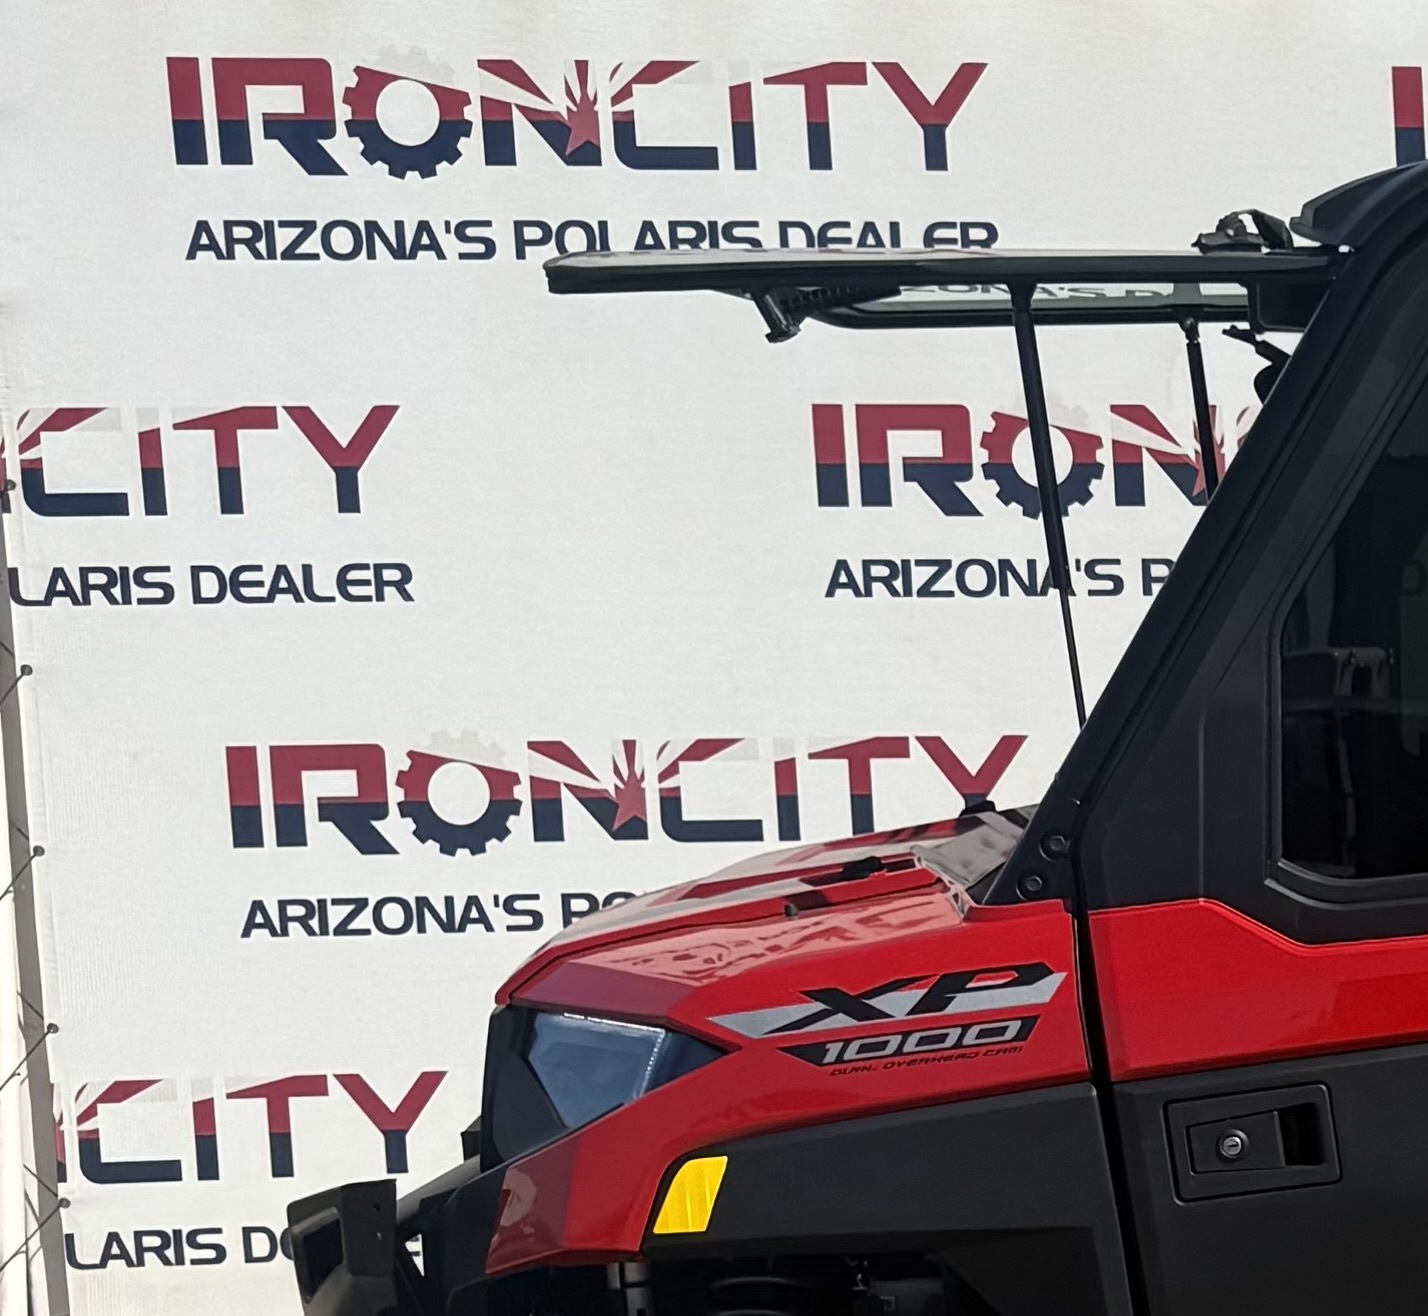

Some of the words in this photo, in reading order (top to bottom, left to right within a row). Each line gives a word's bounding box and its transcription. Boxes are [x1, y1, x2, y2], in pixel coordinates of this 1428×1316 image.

[185, 218, 497, 262] ARIZONA'S
[0, 404, 400, 517] CITY
[8, 565, 175, 606] LARIS
[190, 563, 415, 604] DEALER
[240, 890, 544, 939] ARIZONA'S
[763, 961, 1056, 1035] XP
[821, 1019, 1022, 1064] 1000
[64, 1227, 228, 1270] LARIS
